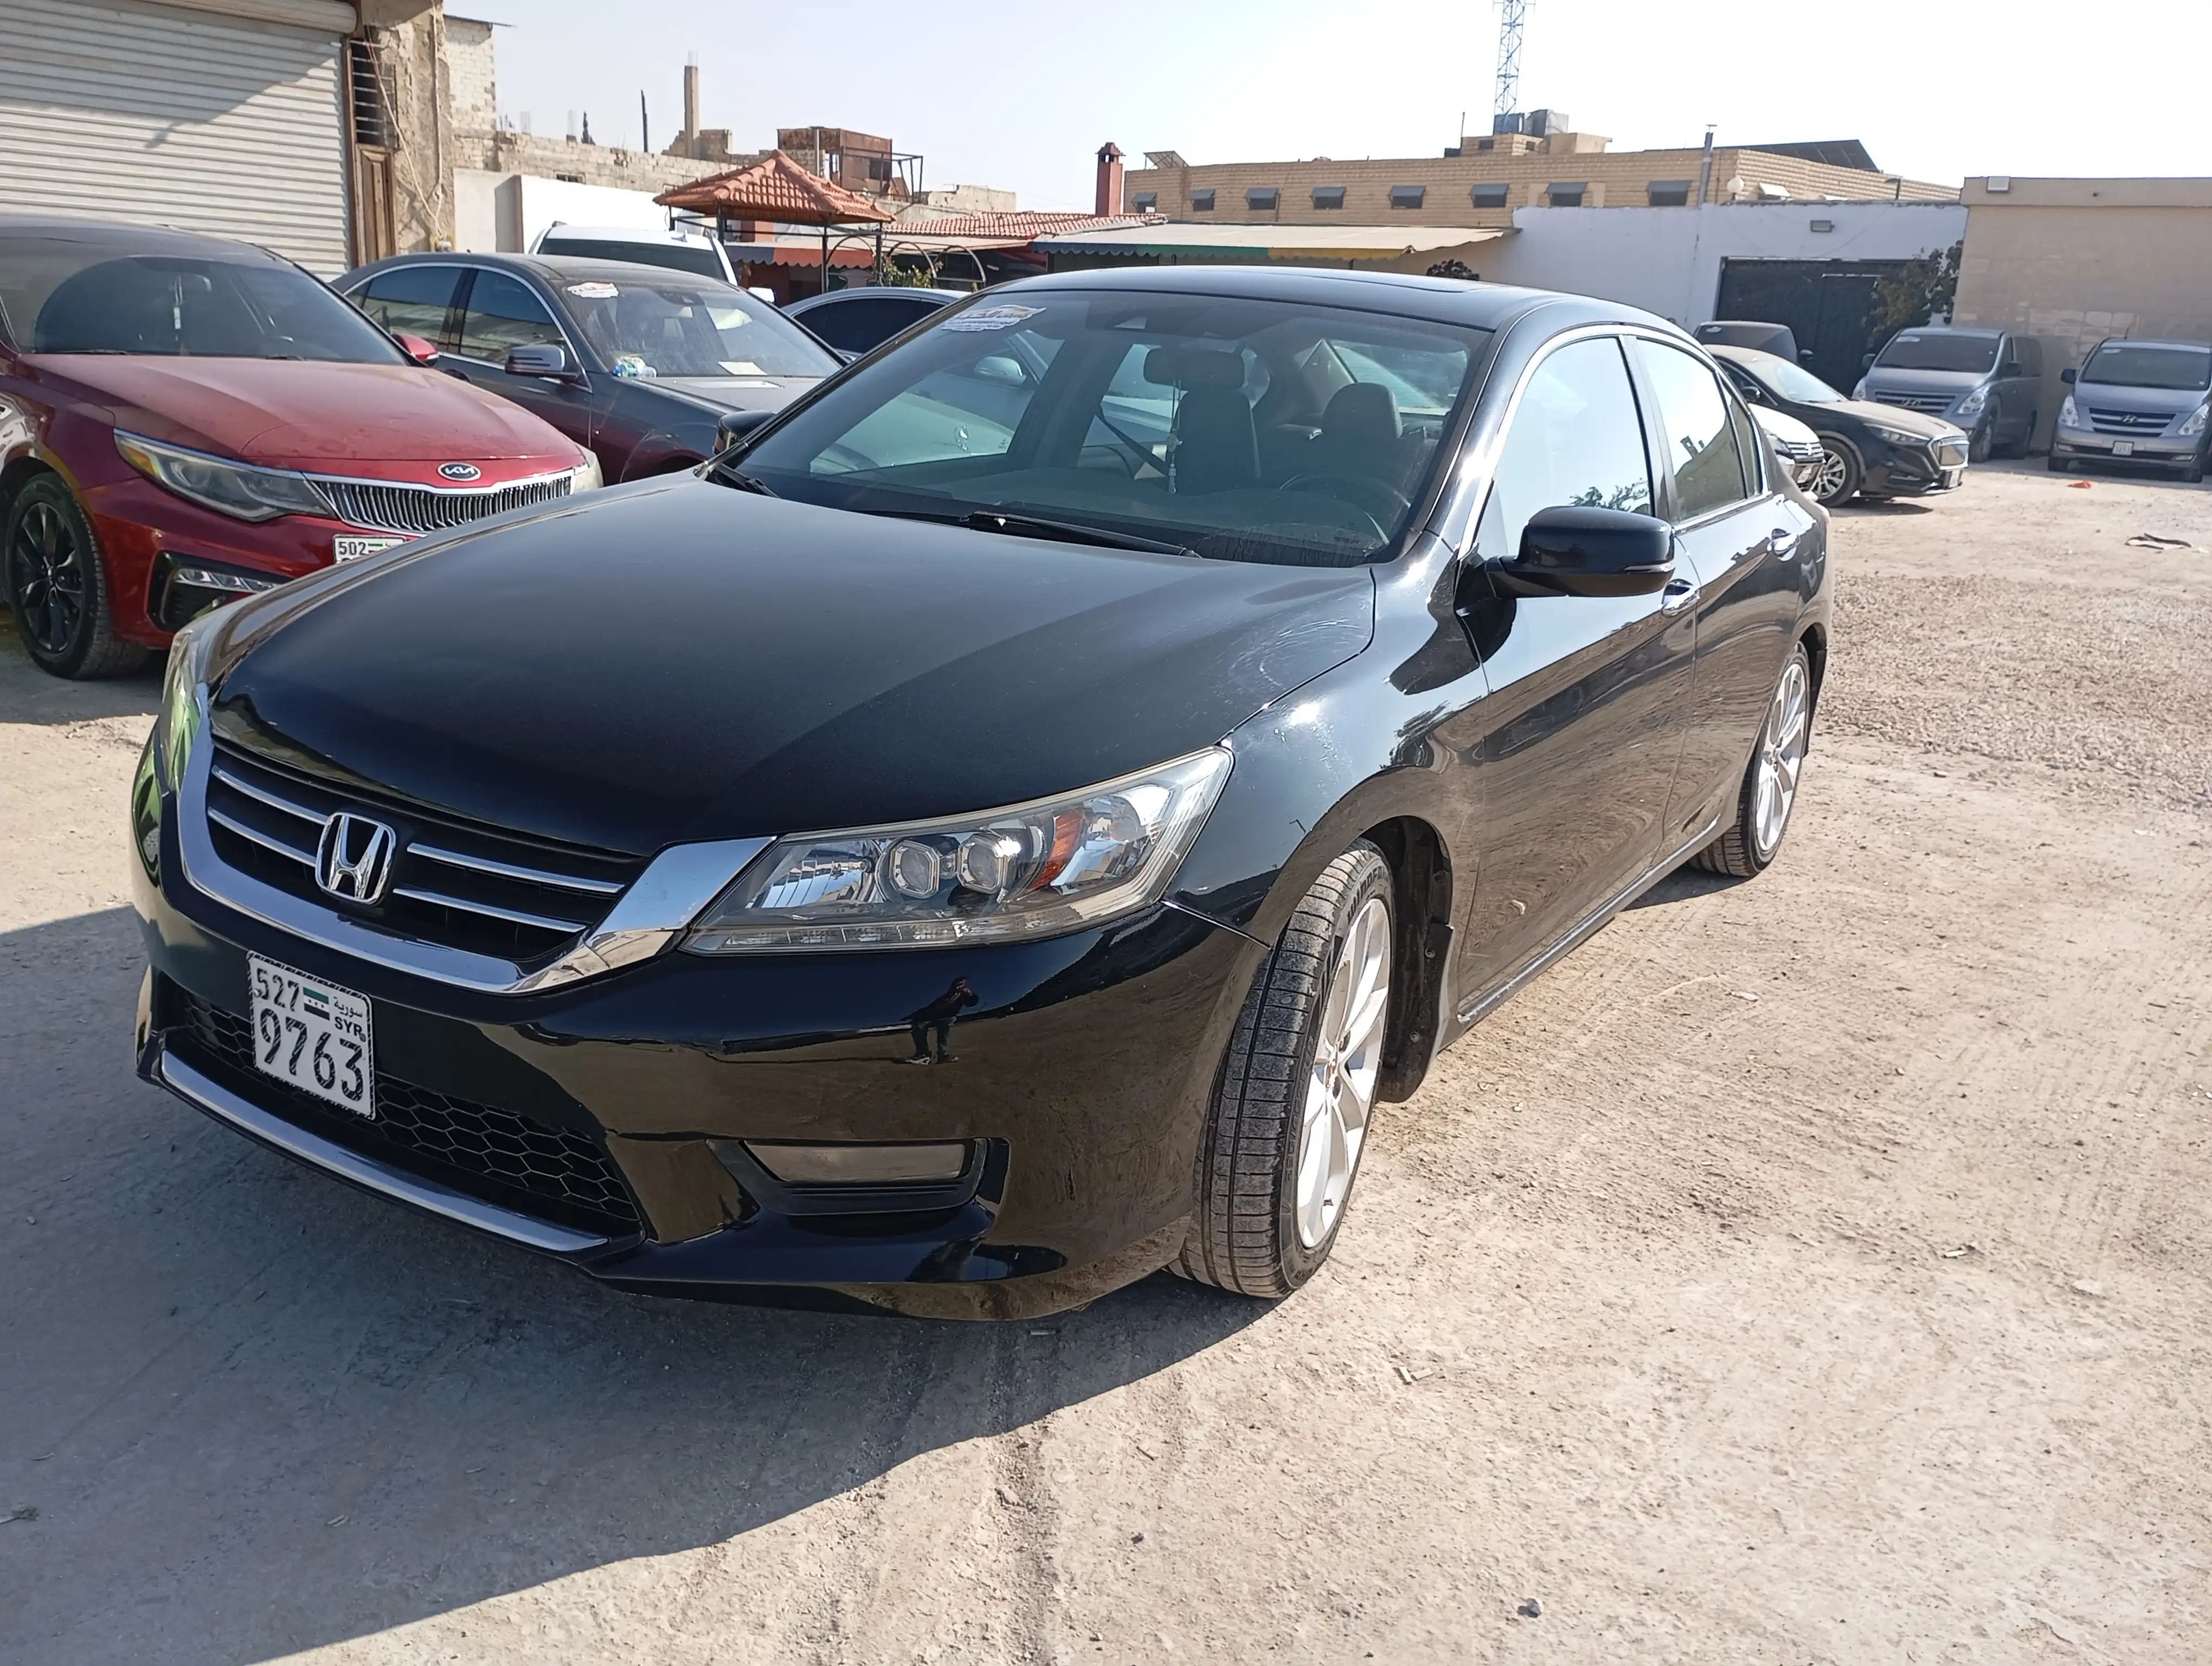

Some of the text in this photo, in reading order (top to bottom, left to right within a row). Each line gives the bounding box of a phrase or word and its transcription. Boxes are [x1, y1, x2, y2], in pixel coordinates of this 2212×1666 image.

[339, 541, 370, 555] 502
[256, 967, 299, 1012] 527
[333, 996, 363, 1018] سورية
[334, 1016, 363, 1037] SYR
[260, 1008, 364, 1102] 9763
